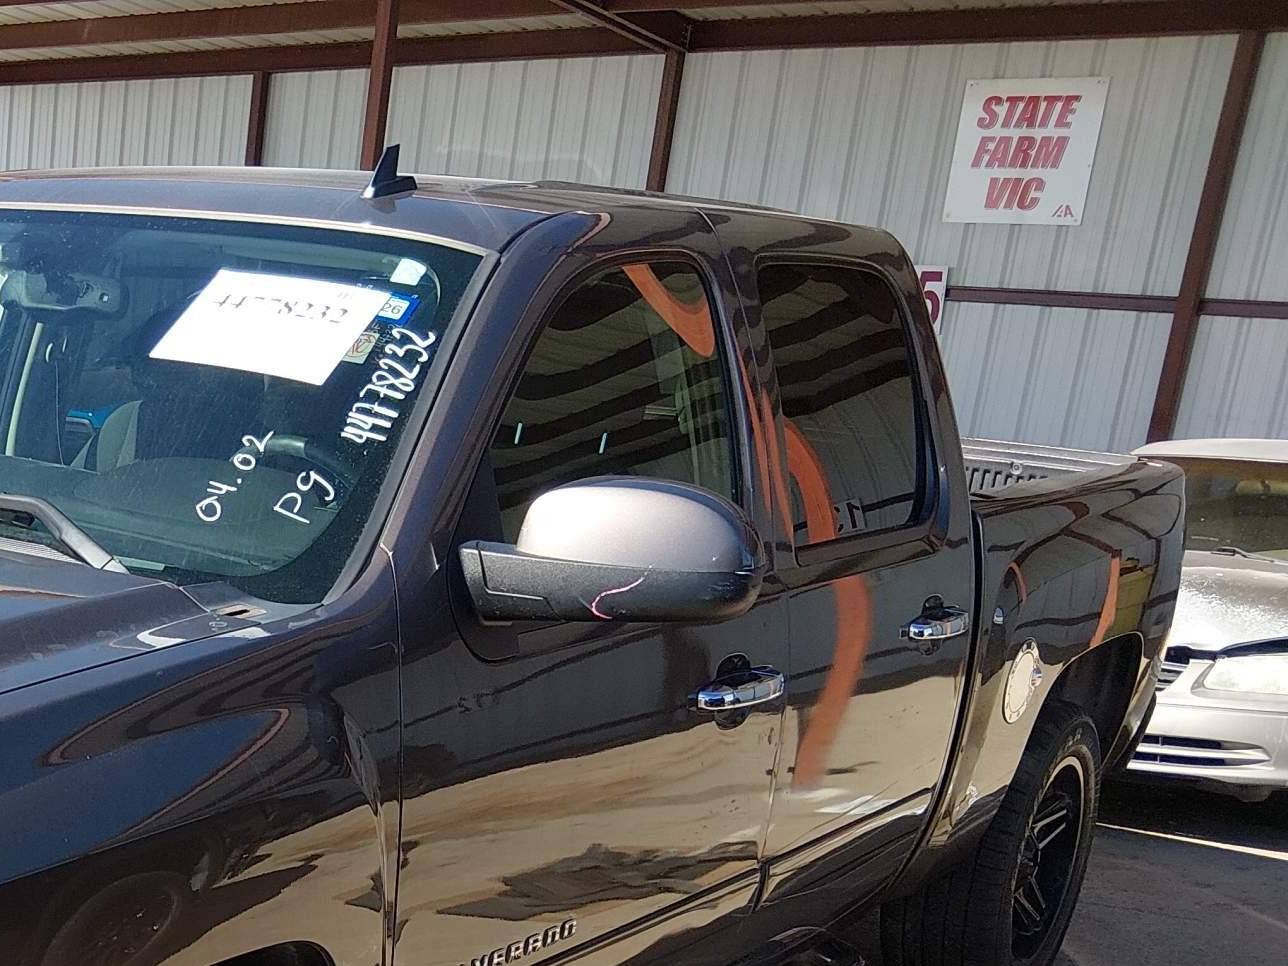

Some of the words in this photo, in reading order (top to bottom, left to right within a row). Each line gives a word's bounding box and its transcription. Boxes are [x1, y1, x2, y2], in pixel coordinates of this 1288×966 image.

[976, 95, 1082, 130] STATE
[970, 135, 1071, 170] FARM
[983, 177, 1047, 211] VIC
[340, 327, 436, 443] 44778232
[195, 430, 275, 522] 04.02
